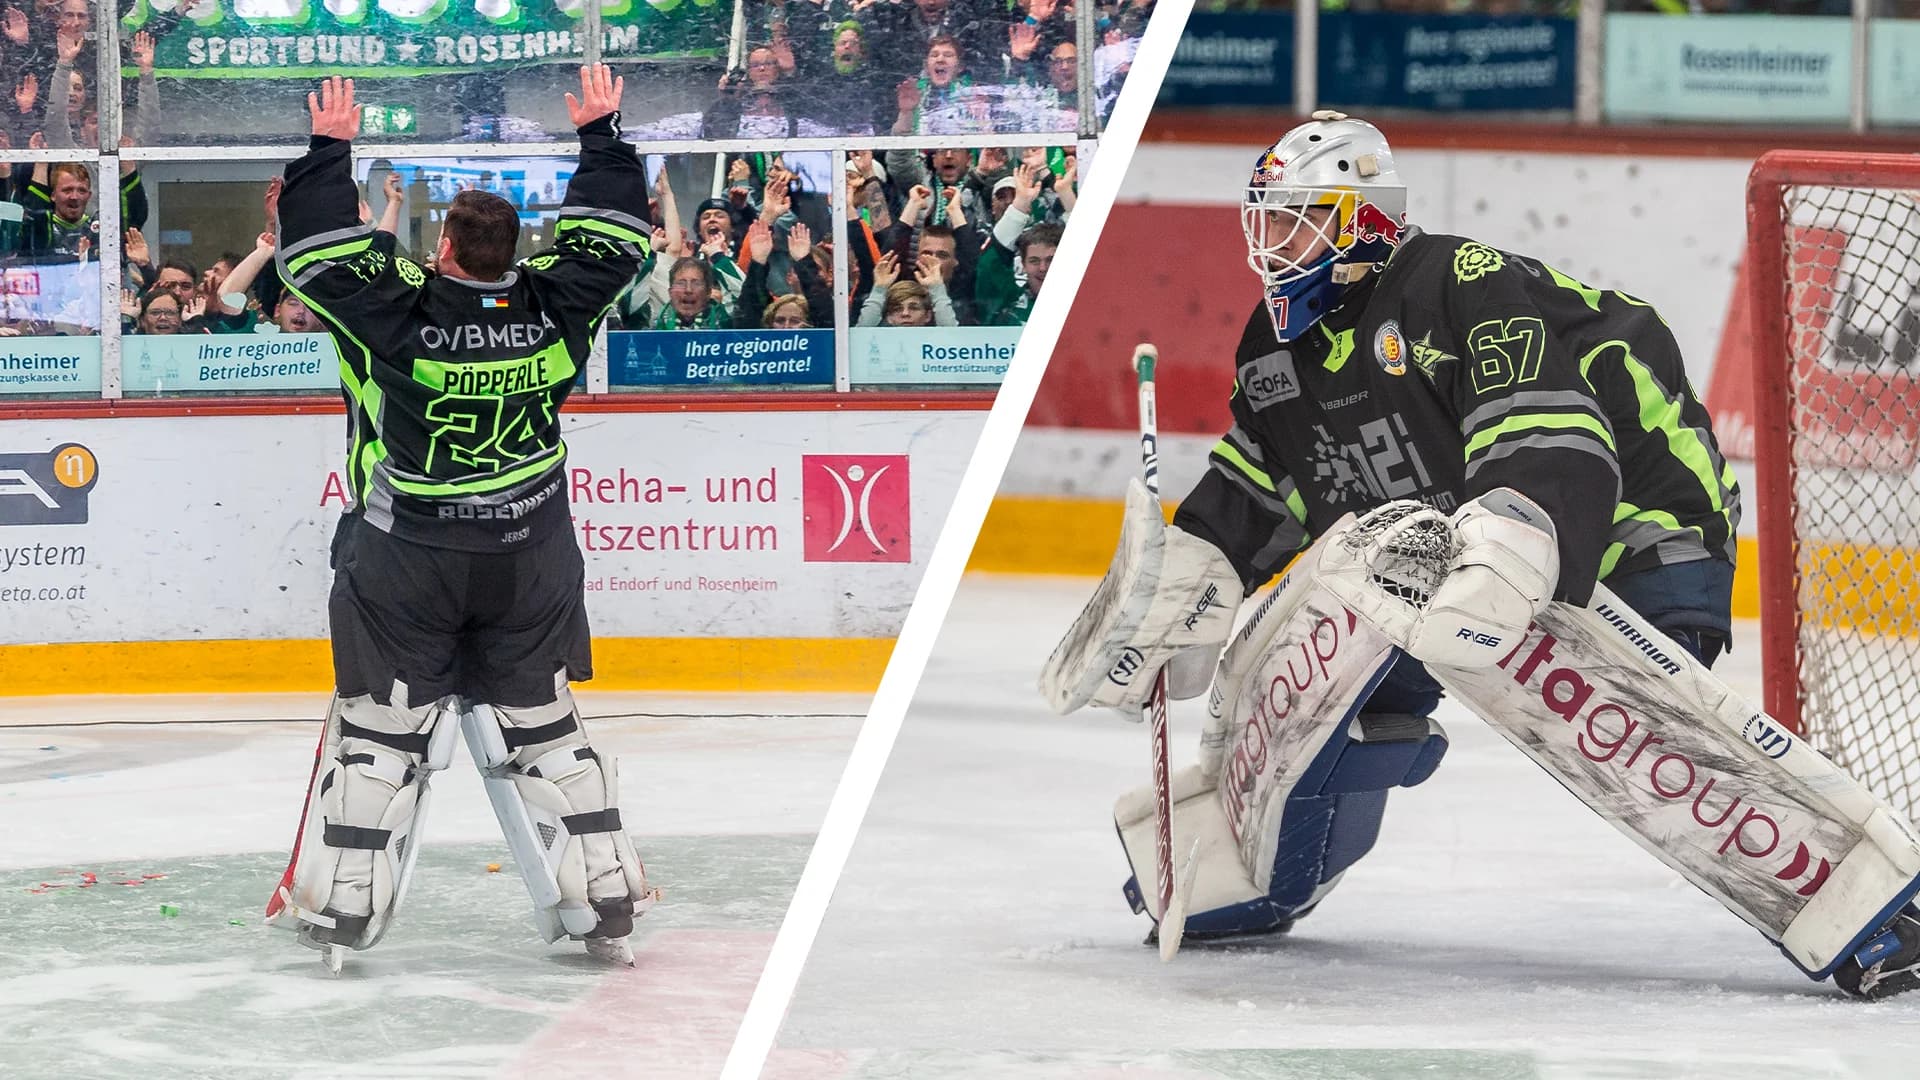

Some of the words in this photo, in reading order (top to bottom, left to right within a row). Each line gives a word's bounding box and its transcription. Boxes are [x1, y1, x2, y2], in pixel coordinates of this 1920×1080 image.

[187, 35, 385, 65] SPORTBUND
[198, 344, 233, 360] Ihre
[238, 337, 319, 361] regionale
[685, 341, 721, 358] Ihre
[725, 334, 809, 359] regionale
[922, 343, 1016, 360] Rosenhei
[1467, 316, 1546, 395] 67
[199, 359, 321, 381] Betriebsrente!
[443, 356, 549, 396] PÖPPERLE
[686, 356, 812, 379] Betriebsrente!
[922, 363, 1010, 375] Unterstützungs
[571, 467, 687, 504] Reha-
[706, 467, 778, 503] und
[570, 517, 778, 551] tszentrum
[0, 542, 86, 573] ystem
[609, 576, 659, 592] Endorf
[664, 578, 692, 592] und
[698, 576, 778, 592] Rosenheim
[1595, 603, 1682, 676] WARRIOR
[1496, 621, 1780, 859] itagroup
